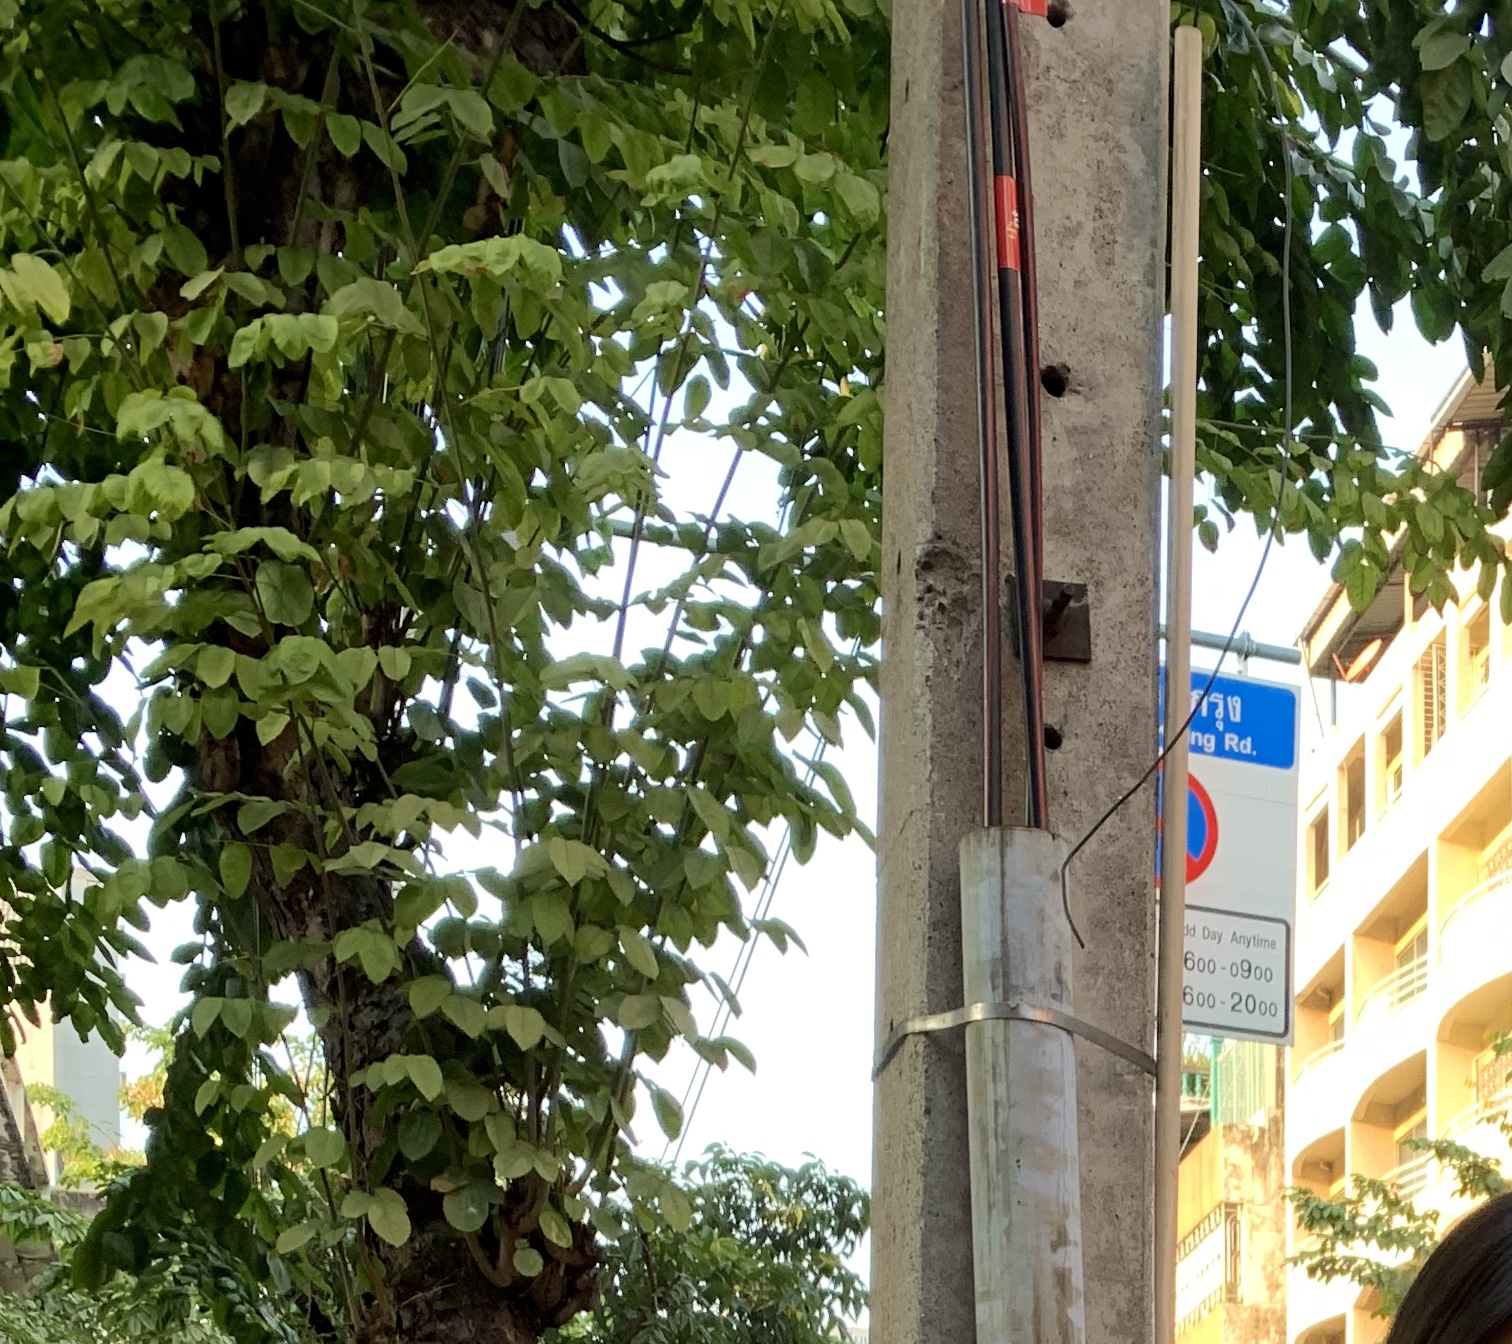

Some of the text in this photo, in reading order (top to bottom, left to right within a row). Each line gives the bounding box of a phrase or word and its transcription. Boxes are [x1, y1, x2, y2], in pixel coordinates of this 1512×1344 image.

[1224, 732, 1257, 756] Rd.
[1184, 924, 1277, 950] dd Day Anytime
[1184, 951, 1273, 983] 600-0900
[1183, 985, 1278, 1017] 600-2000
